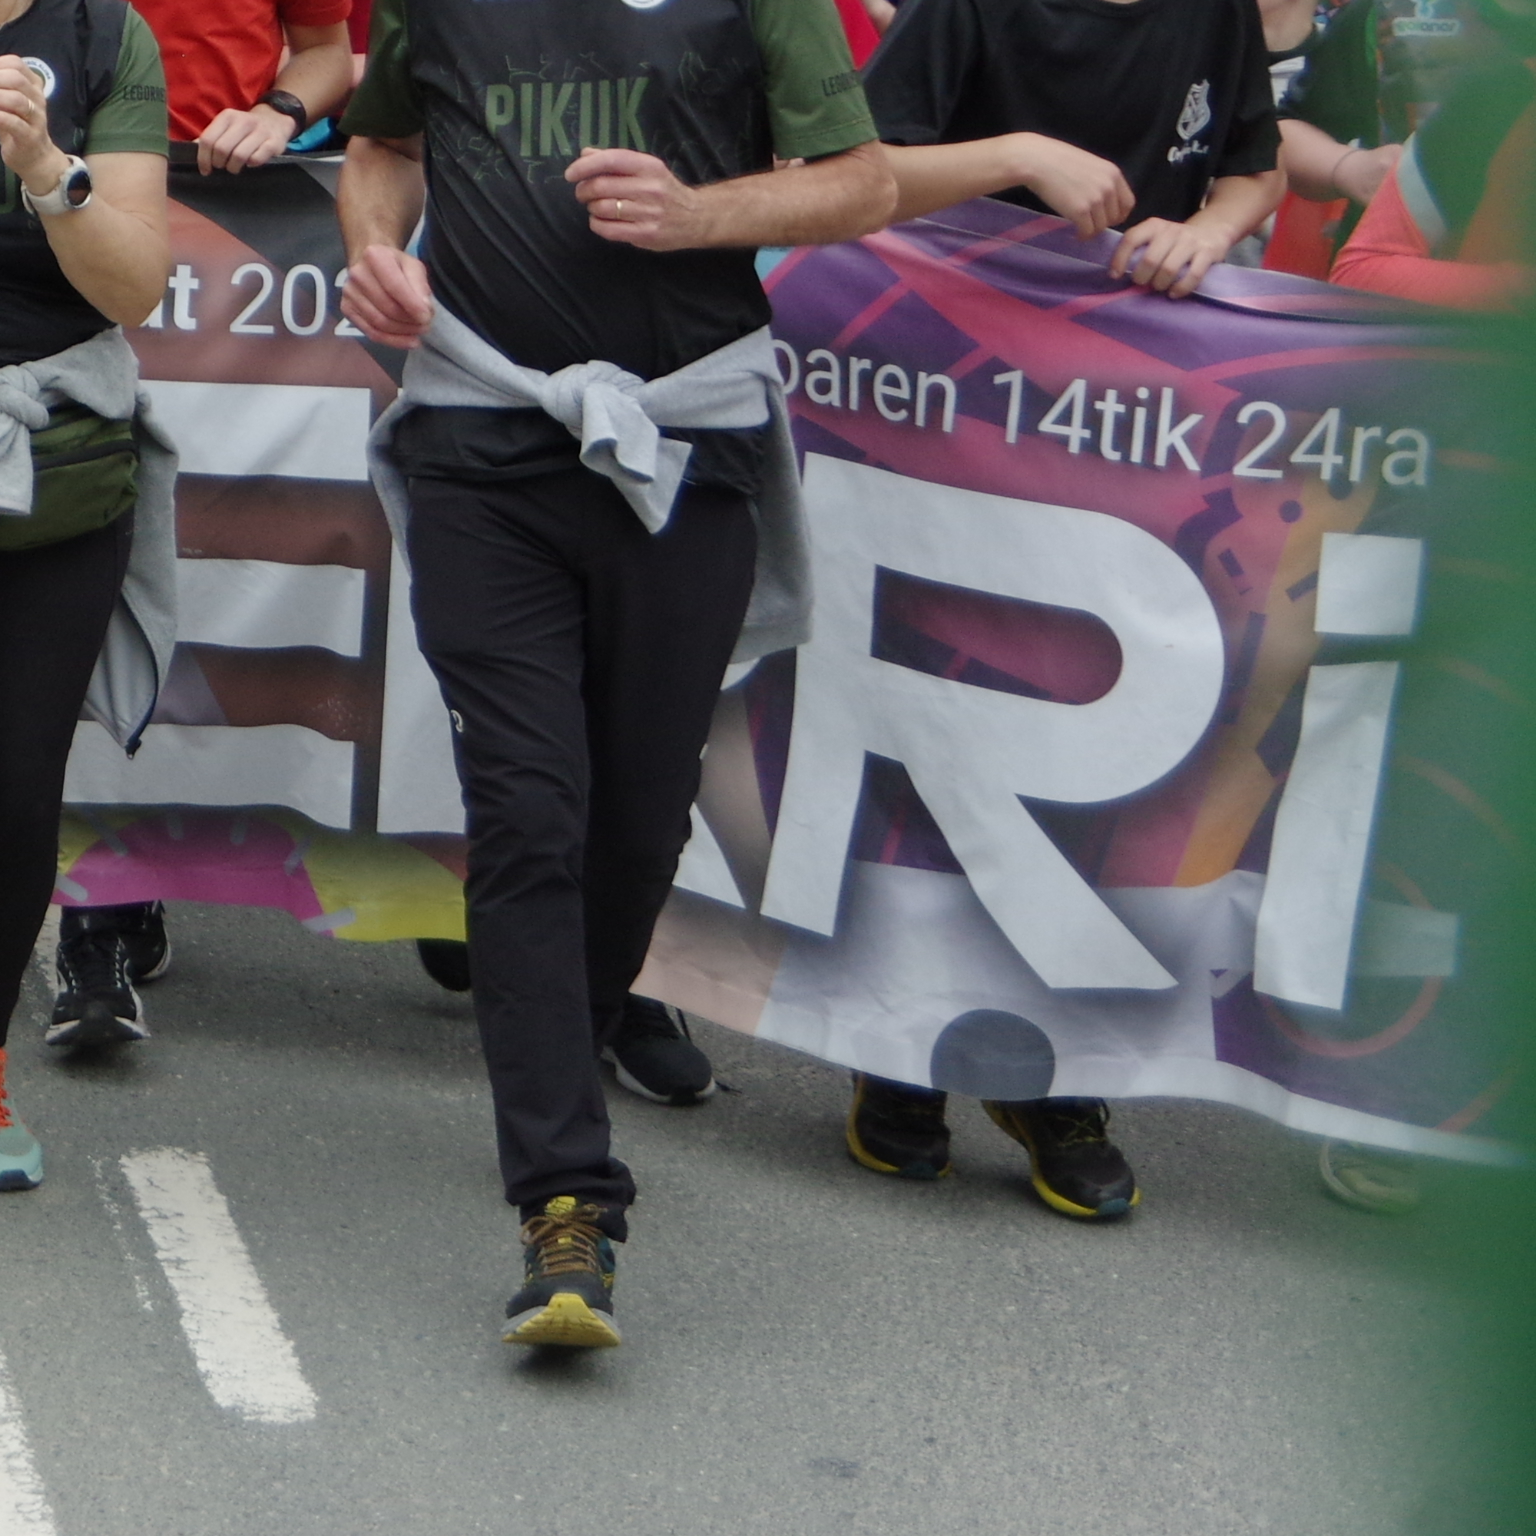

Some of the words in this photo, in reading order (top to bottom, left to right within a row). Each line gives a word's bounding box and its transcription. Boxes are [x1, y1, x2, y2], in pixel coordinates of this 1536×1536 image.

[485, 76, 650, 157] PIKUK
[992, 368, 1204, 473] 14tik
[1232, 399, 1431, 487] 24ra
